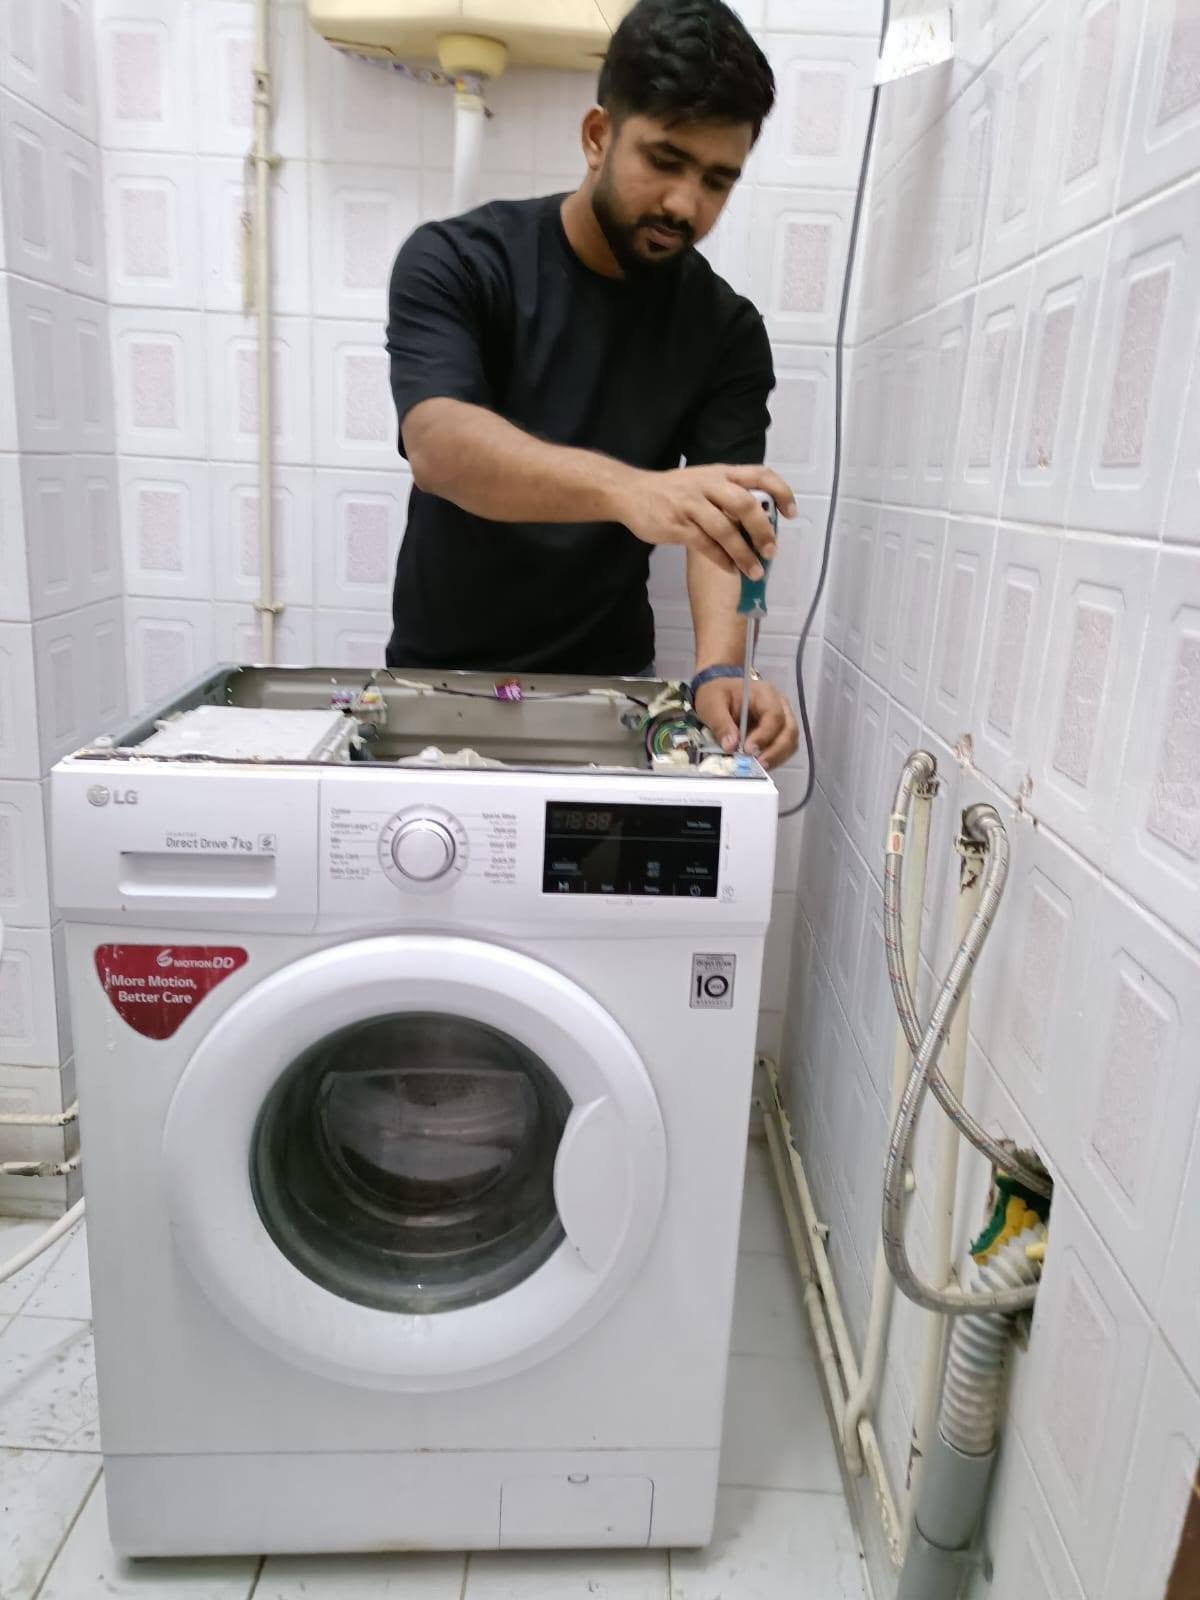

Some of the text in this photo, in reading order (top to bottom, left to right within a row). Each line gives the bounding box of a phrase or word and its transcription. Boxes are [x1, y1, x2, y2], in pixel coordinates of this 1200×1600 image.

[113, 790, 138, 805] LG
[166, 837, 198, 849] Direct
[200, 839, 228, 850] Drive
[111, 975, 197, 990] More Motion,
[118, 991, 192, 1004] Better Care
